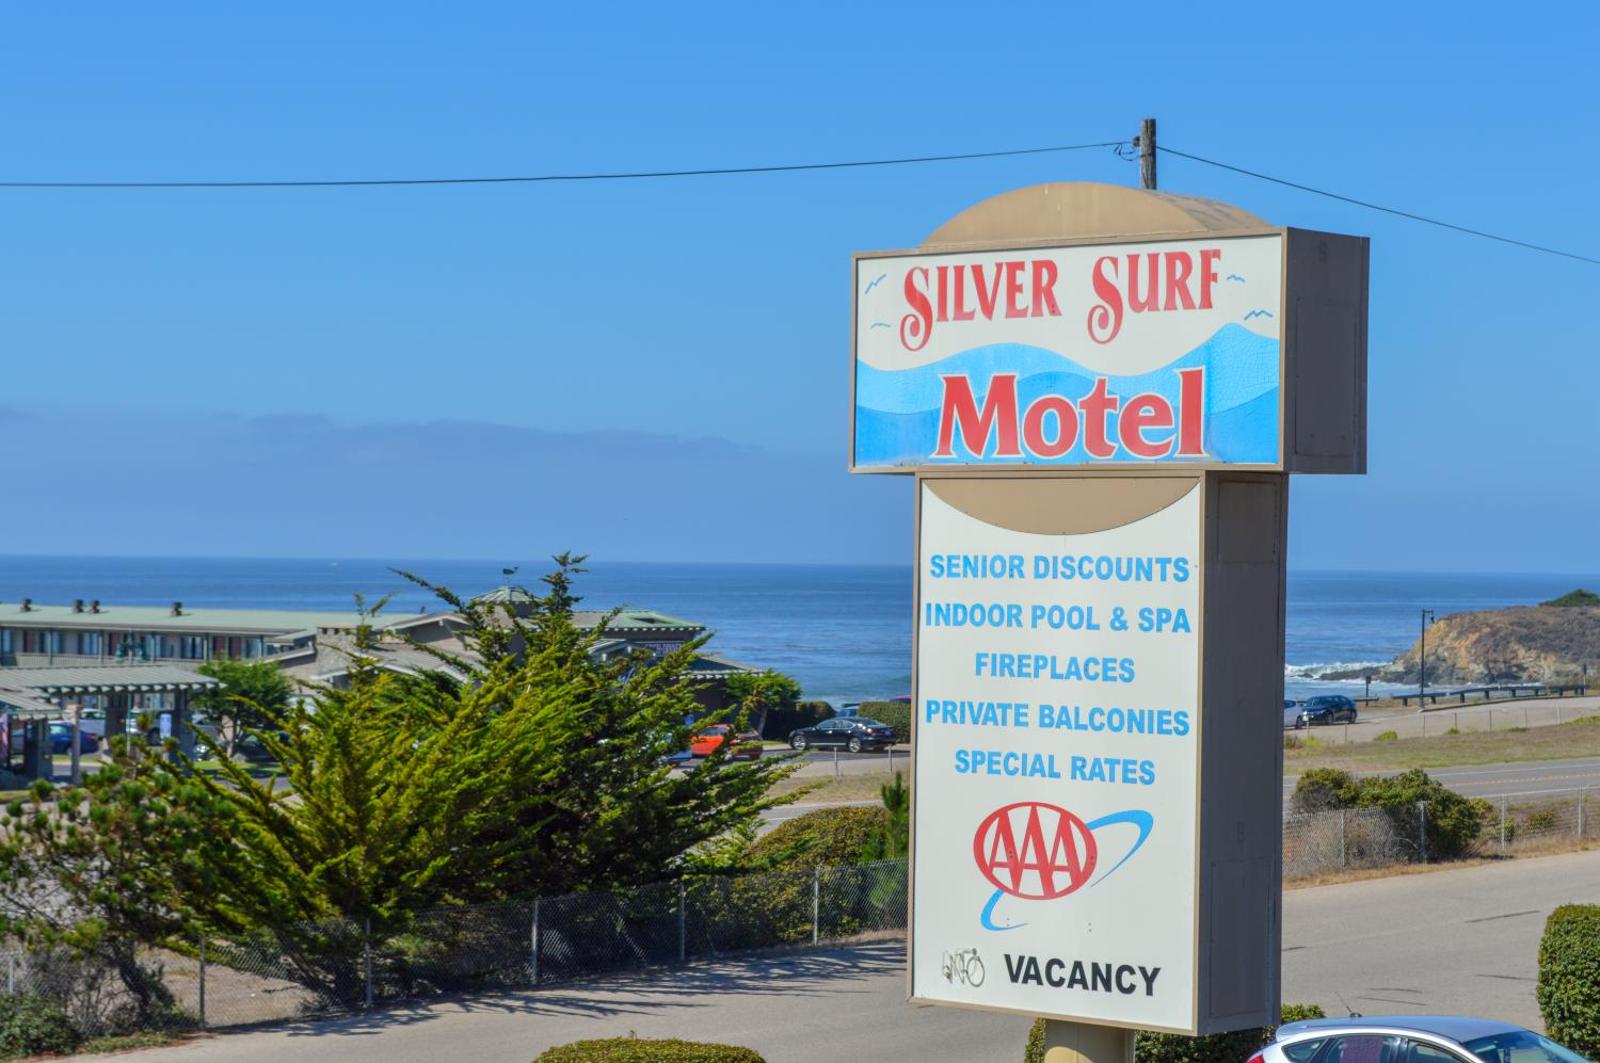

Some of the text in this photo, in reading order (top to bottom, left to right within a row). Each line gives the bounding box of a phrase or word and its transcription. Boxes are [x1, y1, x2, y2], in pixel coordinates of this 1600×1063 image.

[900, 248, 1221, 351] SILVER SURF
[930, 365, 1210, 459] Motel
[929, 554, 1190, 583] SENIOR DISCOUNTS
[925, 602, 1192, 633] INDOOR POOL & SPA
[975, 652, 1136, 683] FIREPLACES
[926, 699, 1191, 736] PRIVATE BALCONIES
[954, 749, 1156, 785] SPECIAL RATES
[985, 803, 1088, 900] AAA
[1003, 953, 1161, 997] VACANCY
